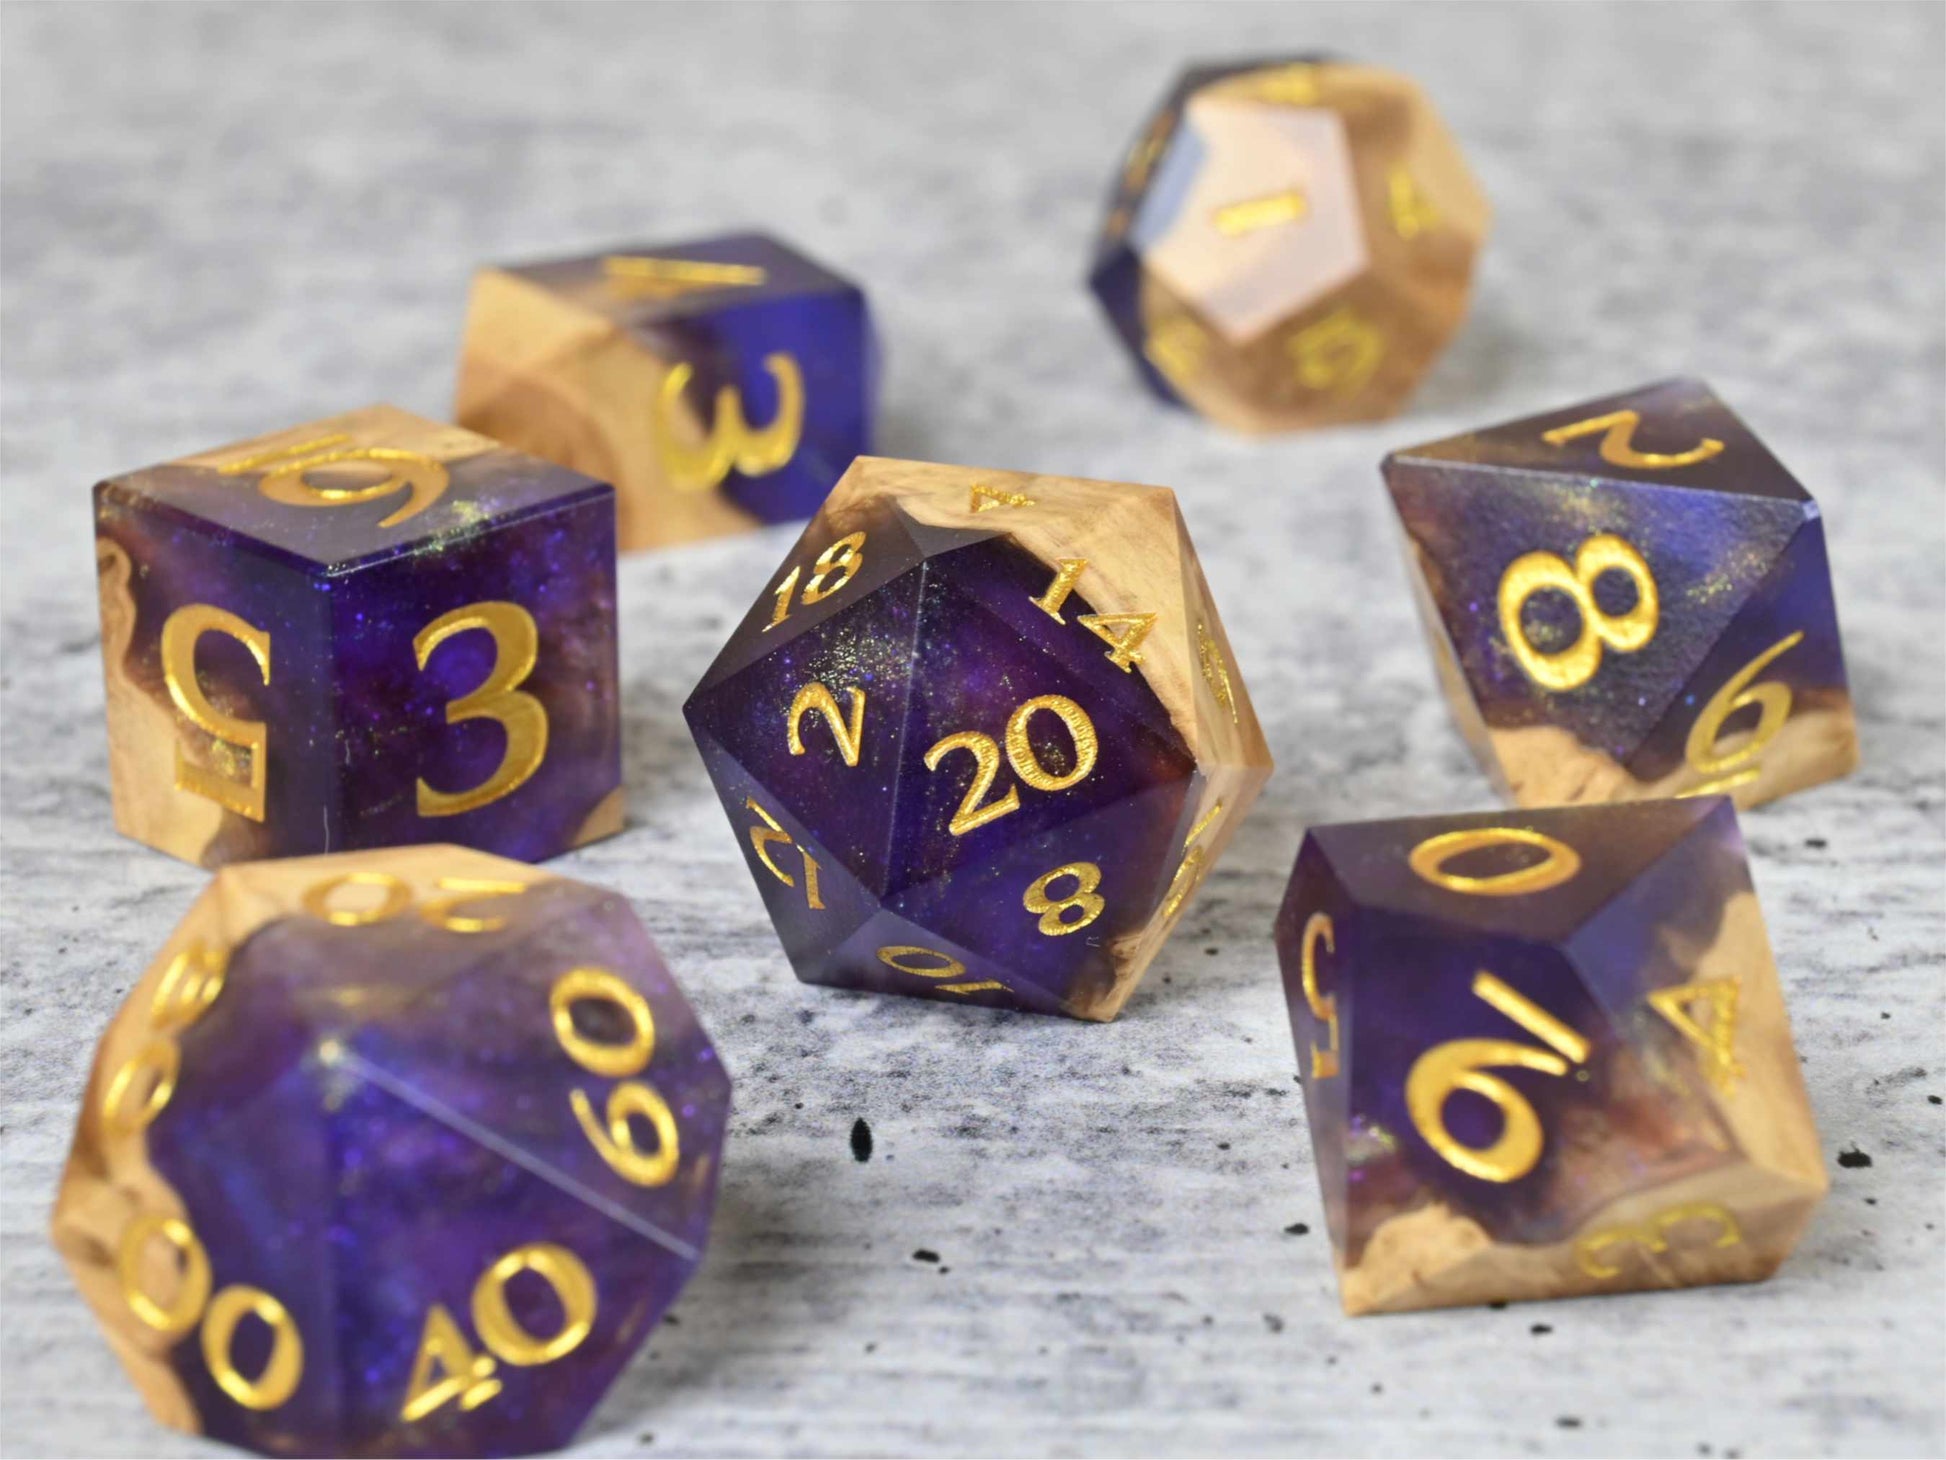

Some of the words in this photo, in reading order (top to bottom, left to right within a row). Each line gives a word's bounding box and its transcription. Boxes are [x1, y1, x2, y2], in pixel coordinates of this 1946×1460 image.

[1214, 187, 1305, 238] 1
[216, 434, 450, 528] 6
[656, 350, 805, 492] 3
[1541, 410, 1725, 469] 2
[762, 531, 866, 633] 18
[1029, 557, 1158, 674] 14
[1499, 533, 1660, 692] 8
[161, 604, 270, 823] 5
[413, 601, 549, 818] 3
[787, 682, 866, 767] 2
[924, 694, 1098, 836] 20
[1674, 629, 1804, 799] 6
[1022, 861, 1105, 937] 8
[1408, 827, 1582, 896] 0
[1648, 976, 1746, 1098] 4
[117, 1214, 305, 1411] 00
[402, 1241, 598, 1424] 40
